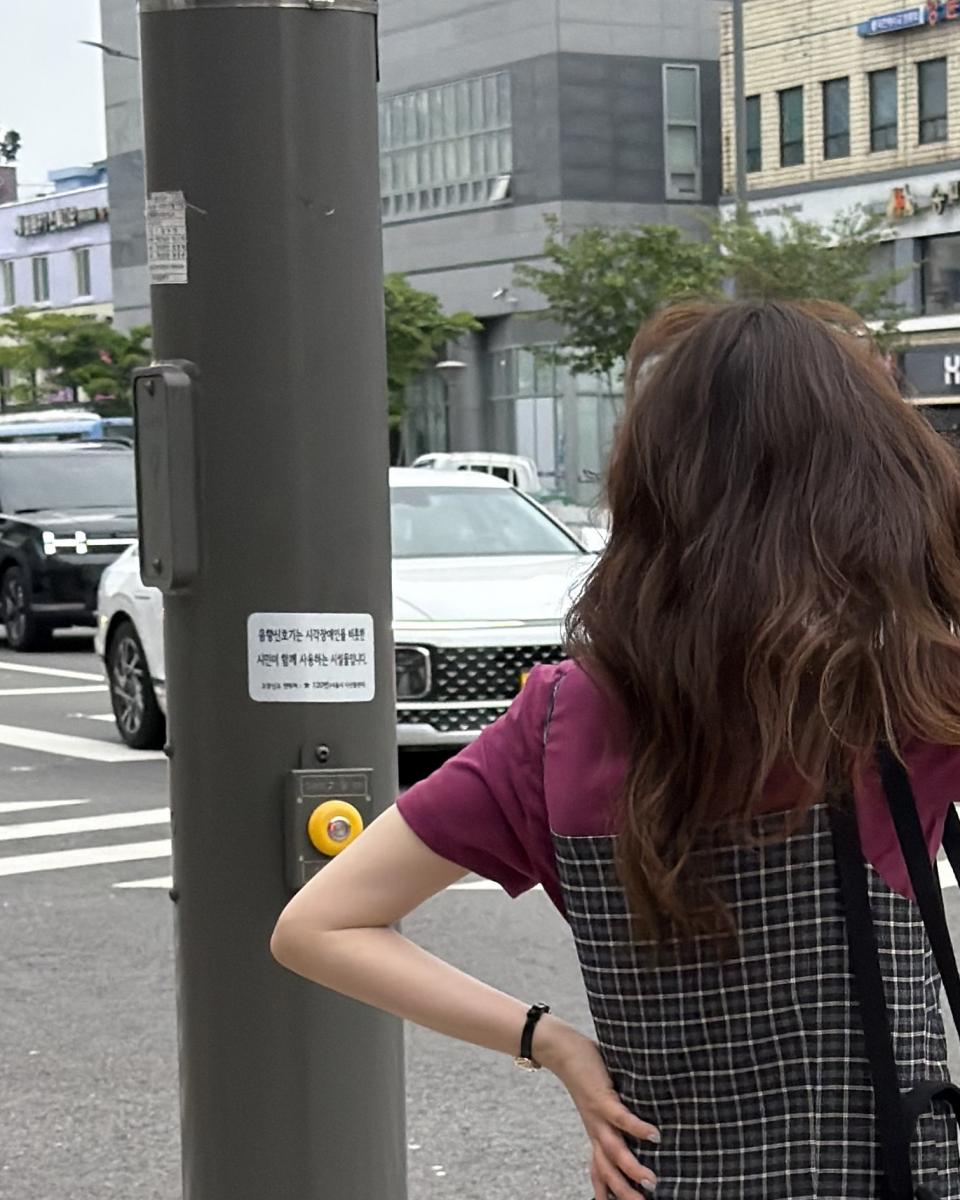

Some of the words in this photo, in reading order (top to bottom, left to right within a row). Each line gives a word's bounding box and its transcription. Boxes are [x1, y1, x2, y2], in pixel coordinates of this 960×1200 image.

[258, 628, 304, 642] 음향신호기는
[306, 628, 346, 642] 시각장애인을
[300, 653, 329, 667] 사용하는
